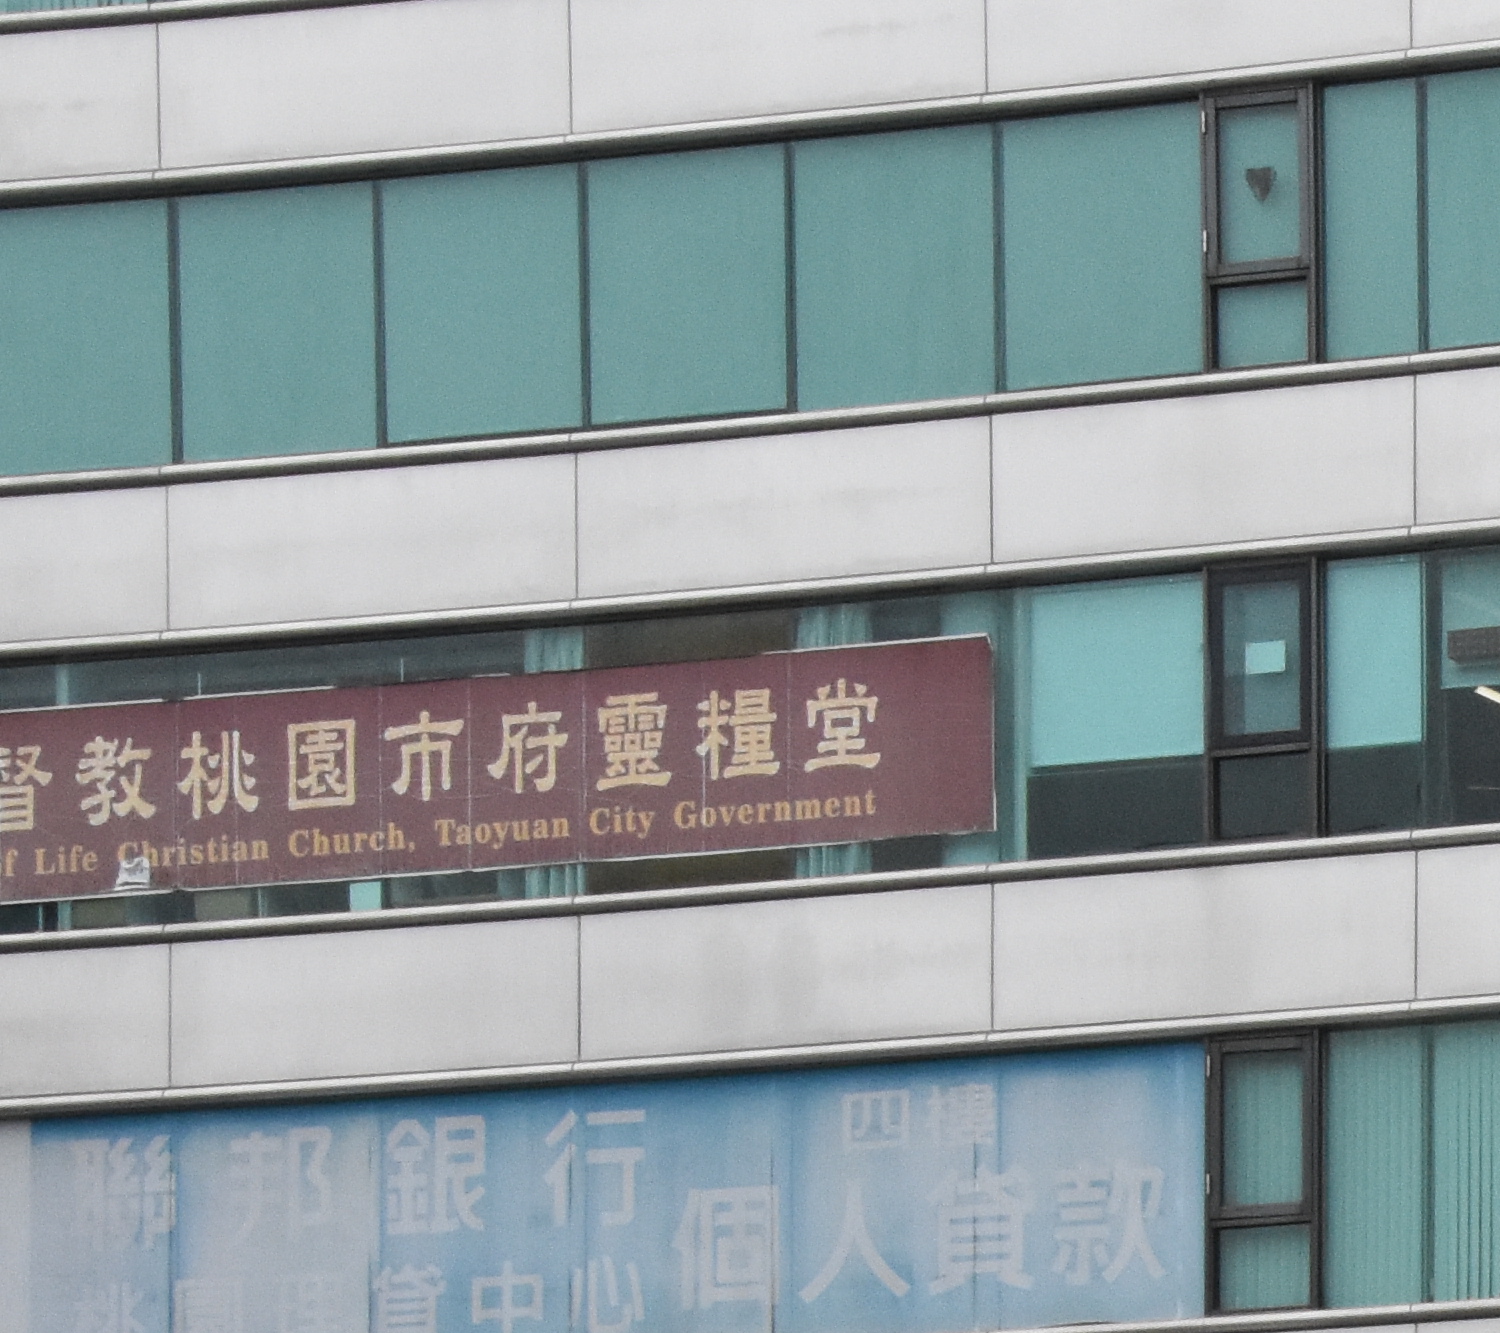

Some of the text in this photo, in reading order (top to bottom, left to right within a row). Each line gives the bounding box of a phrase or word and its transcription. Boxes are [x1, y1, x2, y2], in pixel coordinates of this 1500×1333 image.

[34, 845, 99, 876] Life
[117, 834, 269, 869] Christian
[288, 822, 416, 859] Church,
[435, 813, 570, 849] Taoyuan
[588, 806, 655, 842] City
[674, 788, 878, 830] Government
[838, 1079, 998, 1155] 四樓
[70, 1107, 648, 1254] 聯邦銀行
[670, 1164, 1168, 1313] 個人貸款
